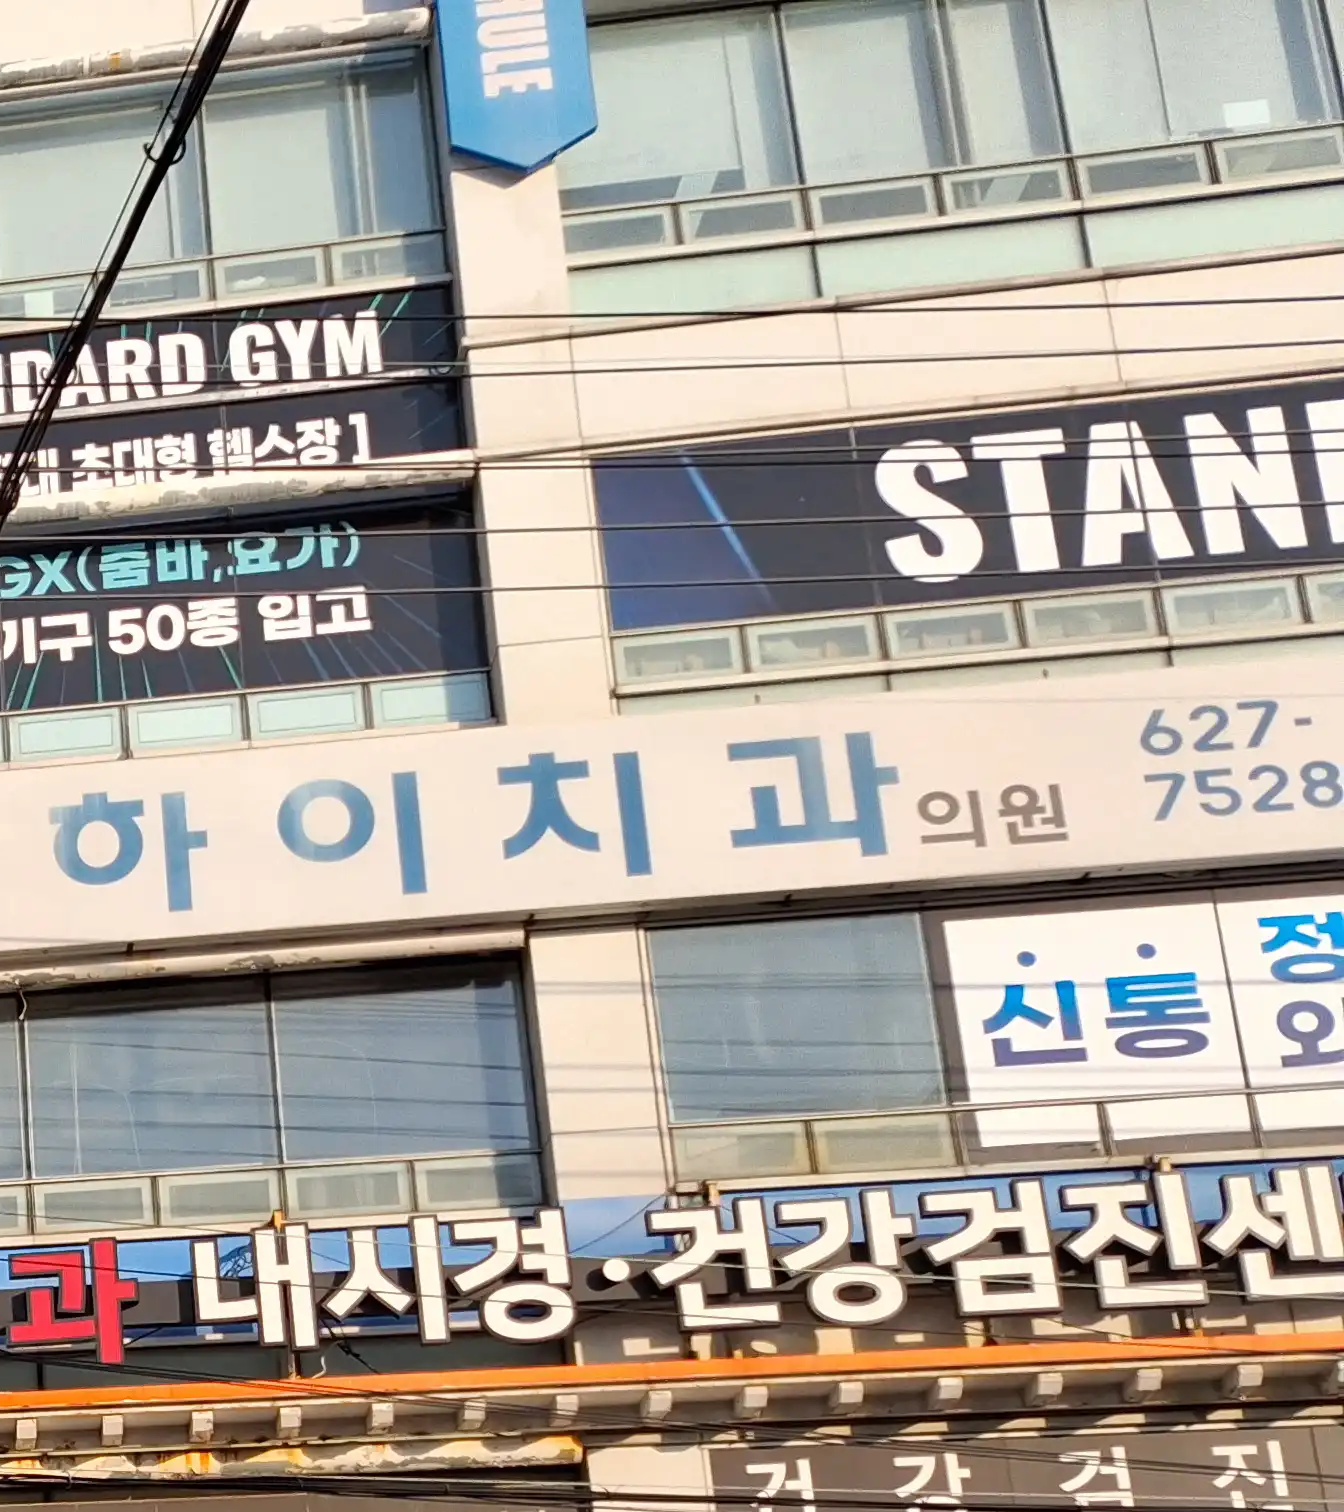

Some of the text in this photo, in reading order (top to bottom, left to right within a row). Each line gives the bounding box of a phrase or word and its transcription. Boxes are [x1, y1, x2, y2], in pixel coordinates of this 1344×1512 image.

[229, 310, 384, 387] GYM
[72, 433, 196, 490] 초대형
[108, 597, 239, 655] 50종
[258, 586, 373, 641] 입고
[1144, 761, 1344, 821] 7528
